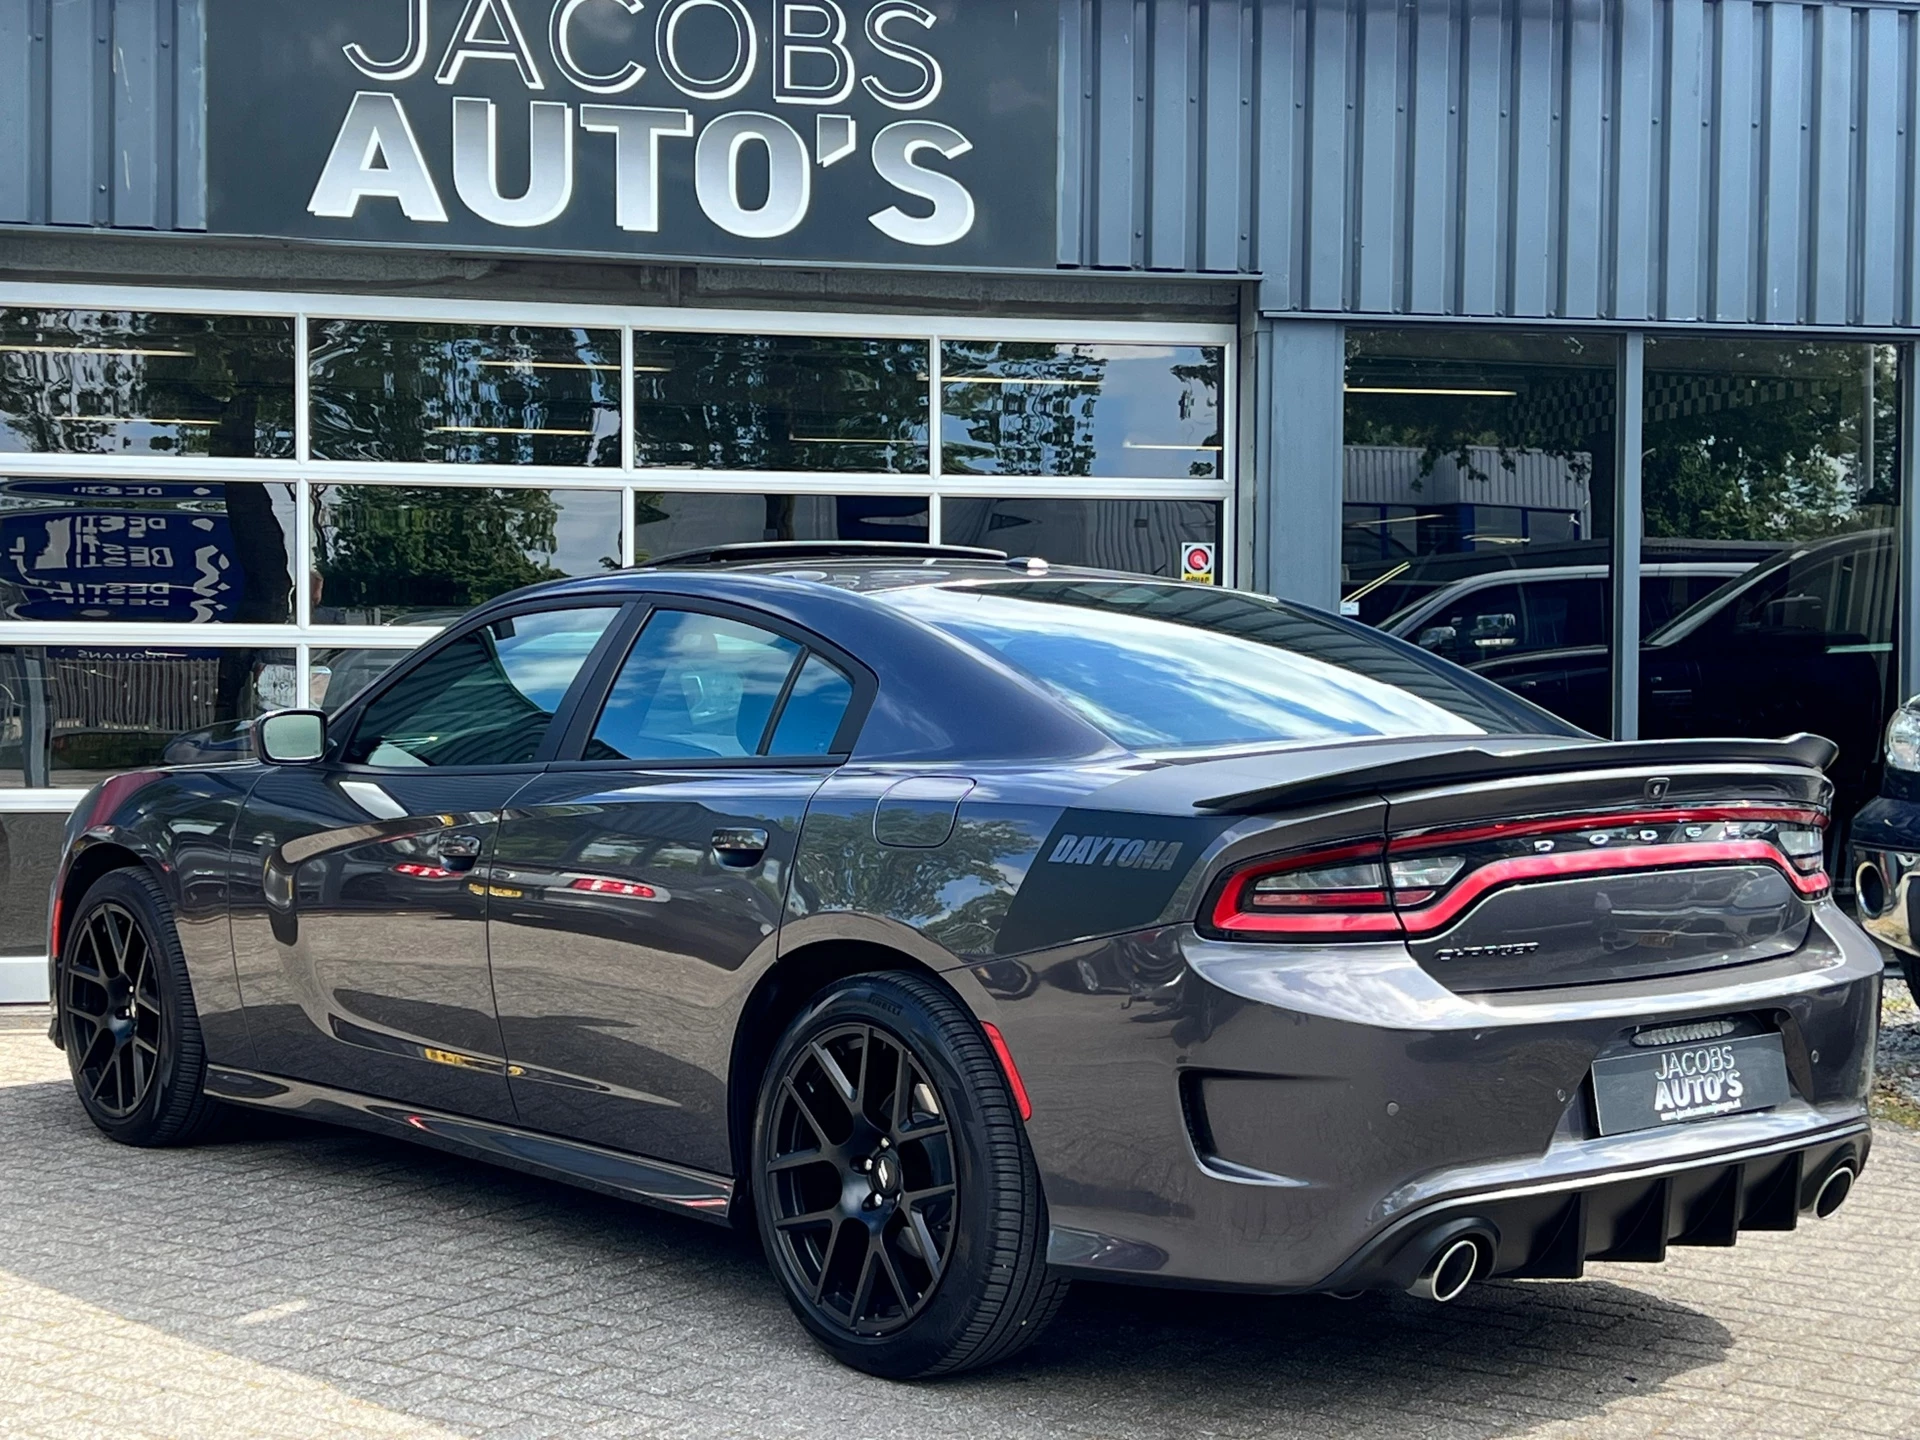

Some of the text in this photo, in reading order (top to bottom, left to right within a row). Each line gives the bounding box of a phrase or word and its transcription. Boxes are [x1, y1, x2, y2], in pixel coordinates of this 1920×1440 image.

[343, 0, 942, 110] JACOBS
[307, 91, 975, 246] AUTO'S
[1048, 834, 1183, 871] DAYTONA
[1655, 1045, 1735, 1080] JACOBS
[1654, 1069, 1744, 1111] AUTO'S
